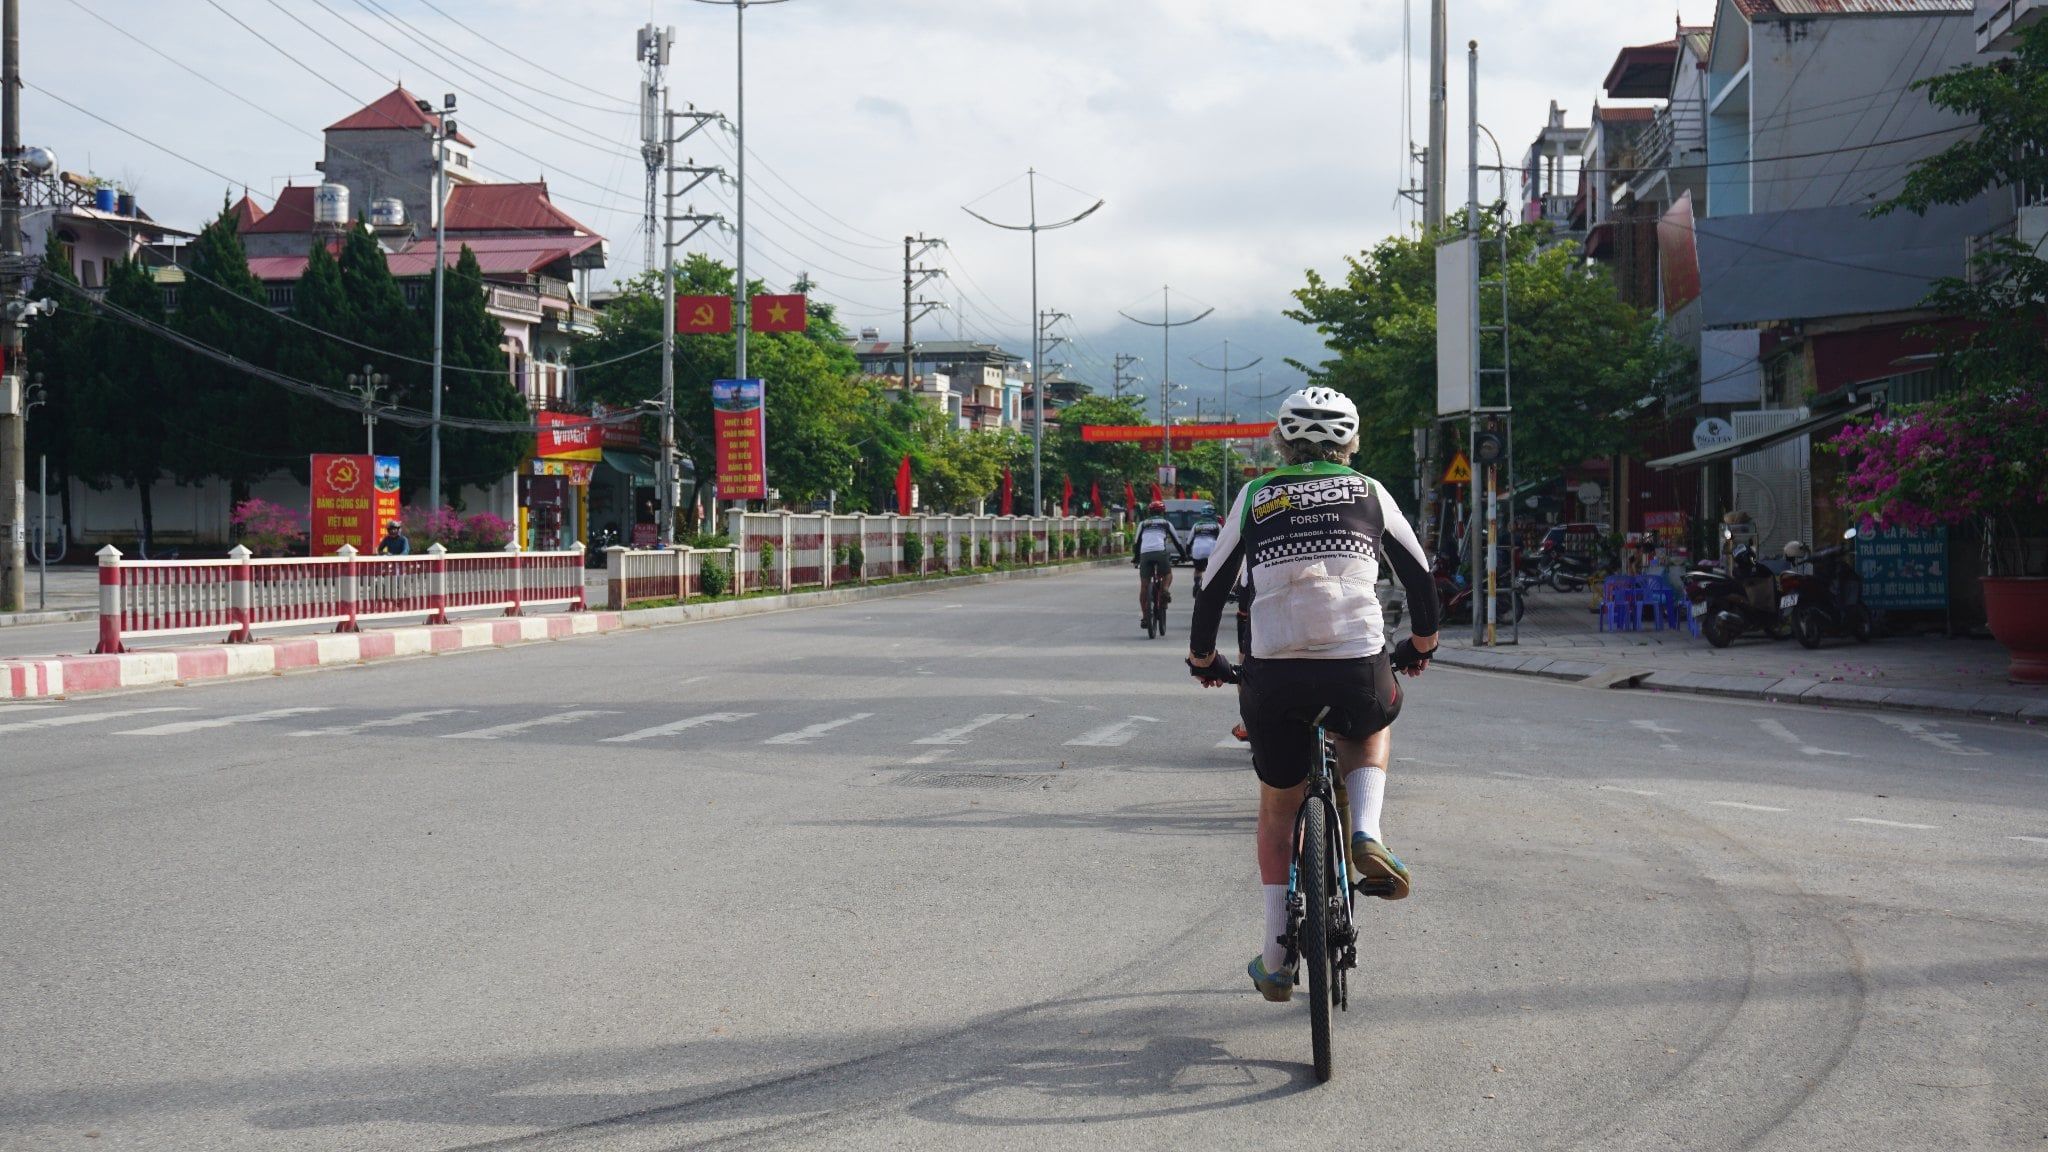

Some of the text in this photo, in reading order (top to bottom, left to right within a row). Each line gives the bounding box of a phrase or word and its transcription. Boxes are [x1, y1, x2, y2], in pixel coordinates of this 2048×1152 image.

[1254, 477, 1363, 507] BANGERS
[1300, 486, 1350, 506] NOI
[336, 495, 354, 511] CỘNG
[327, 514, 357, 529] VIỆT NAM
[1290, 513, 1339, 525] FORSYTH
[1258, 534, 1284, 547] THAILAND
[1290, 530, 1324, 538] CAMBODIA
